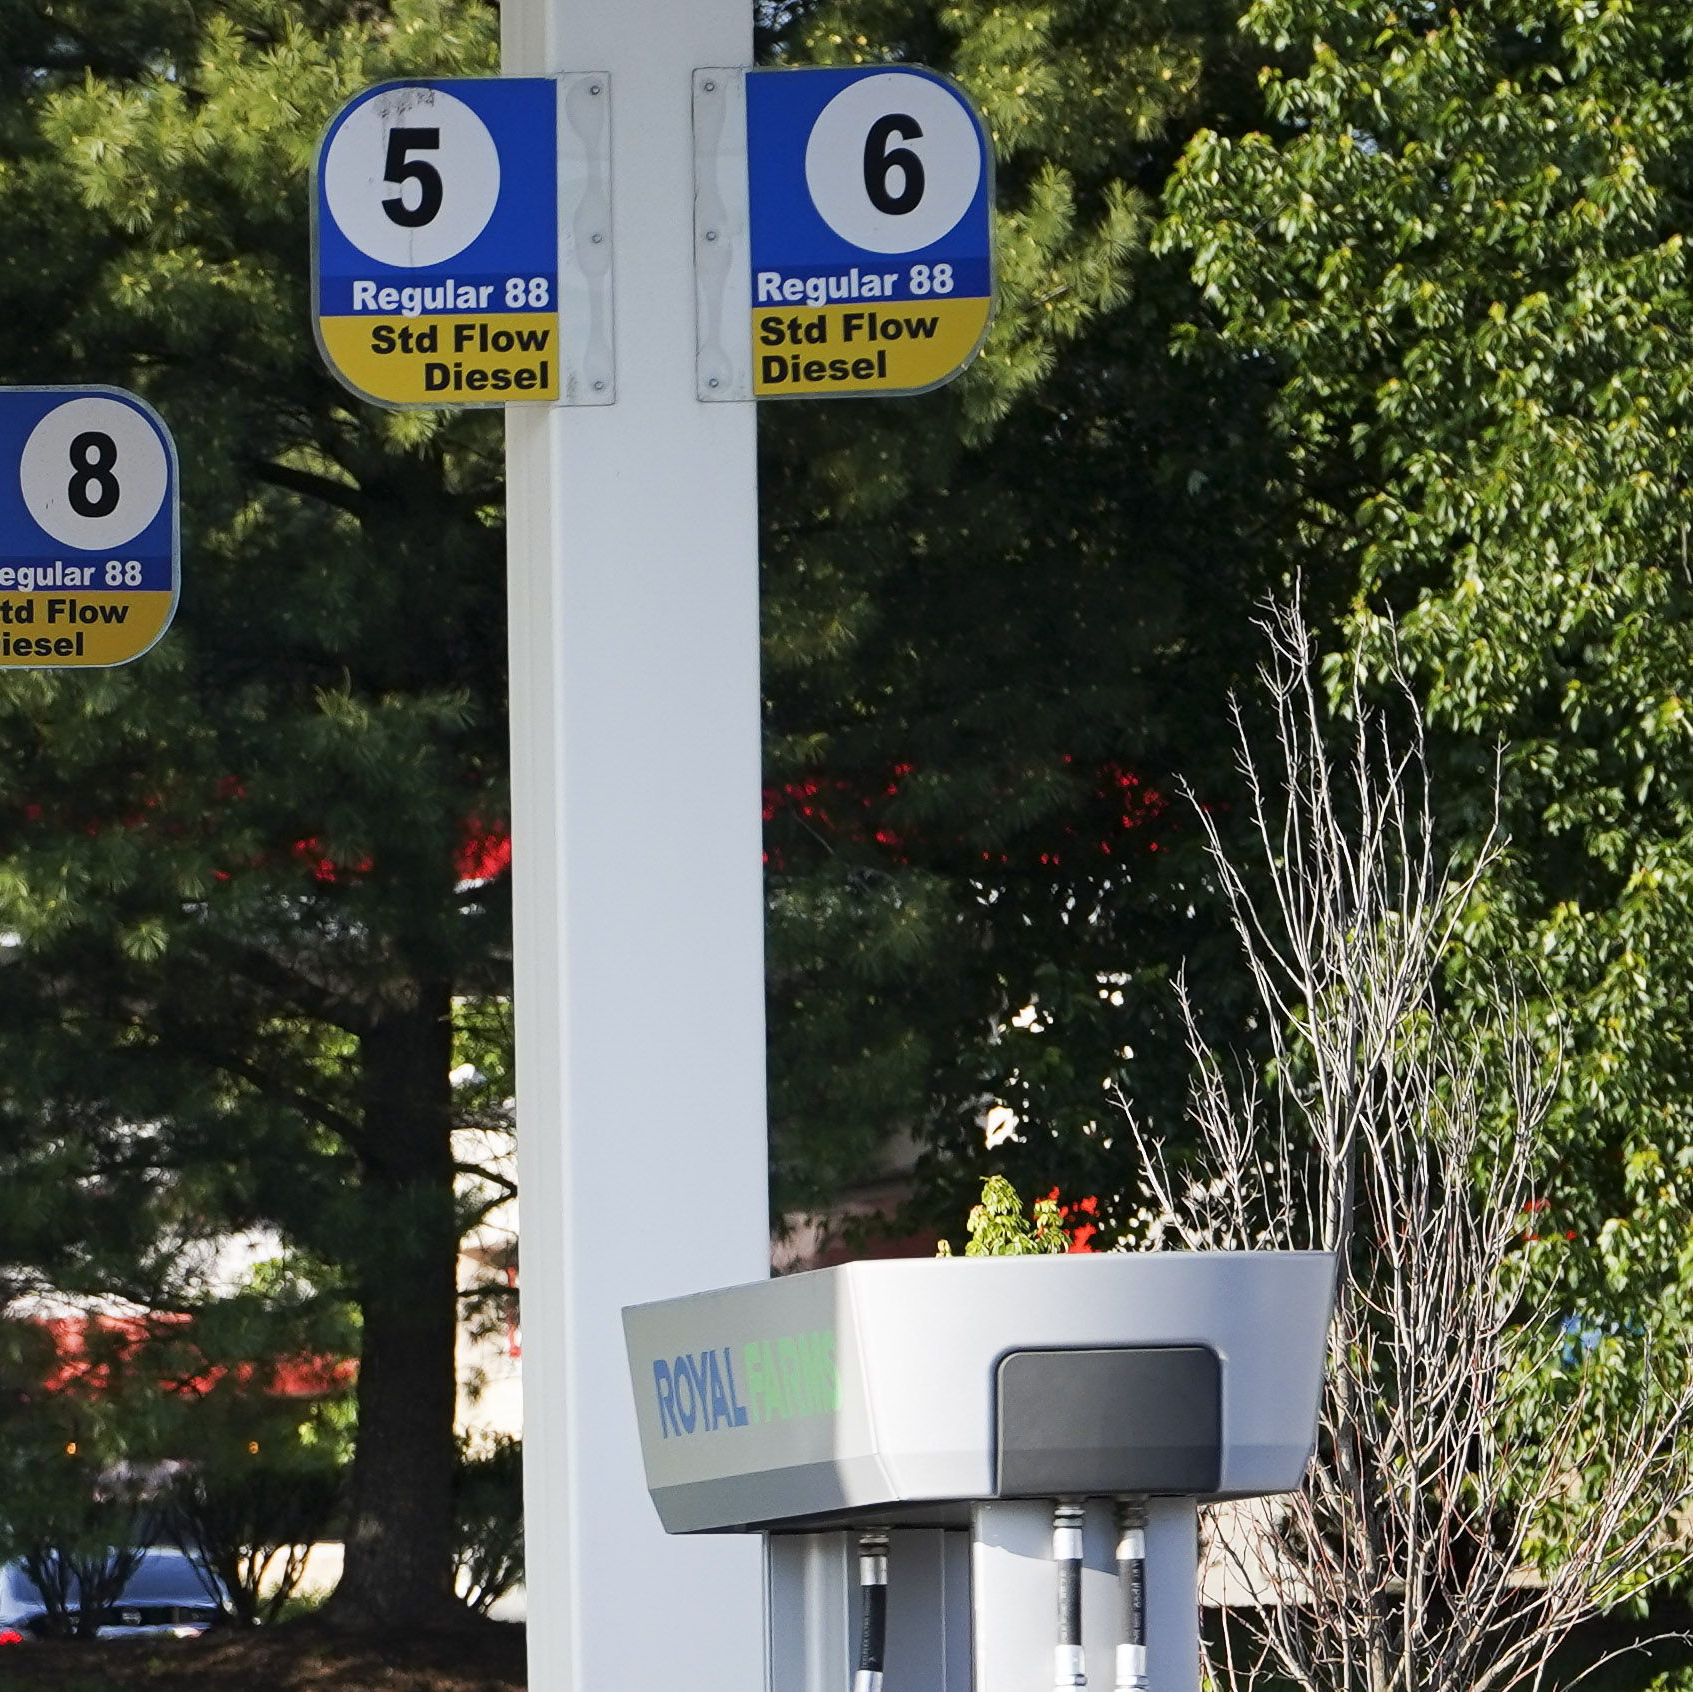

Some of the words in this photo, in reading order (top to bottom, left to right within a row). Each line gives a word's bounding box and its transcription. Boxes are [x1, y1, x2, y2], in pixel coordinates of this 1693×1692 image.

[381, 127, 443, 228] 5
[863, 113, 925, 216] 6
[353, 280, 494, 318] Regular
[505, 278, 550, 307] 88
[758, 269, 897, 308] Regular
[910, 264, 954, 296] 88
[371, 325, 439, 355] Std
[454, 323, 550, 353] Flow
[761, 314, 828, 346] Std
[843, 313, 940, 342] Flow
[424, 361, 550, 392] Diesel
[762, 353, 887, 384] Diesel
[68, 431, 120, 518] 8
[105, 561, 142, 587] 88
[48, 599, 130, 624] Flow
[653, 1347, 749, 1439] ROYAL
[745, 1331, 841, 1423] FARMS
